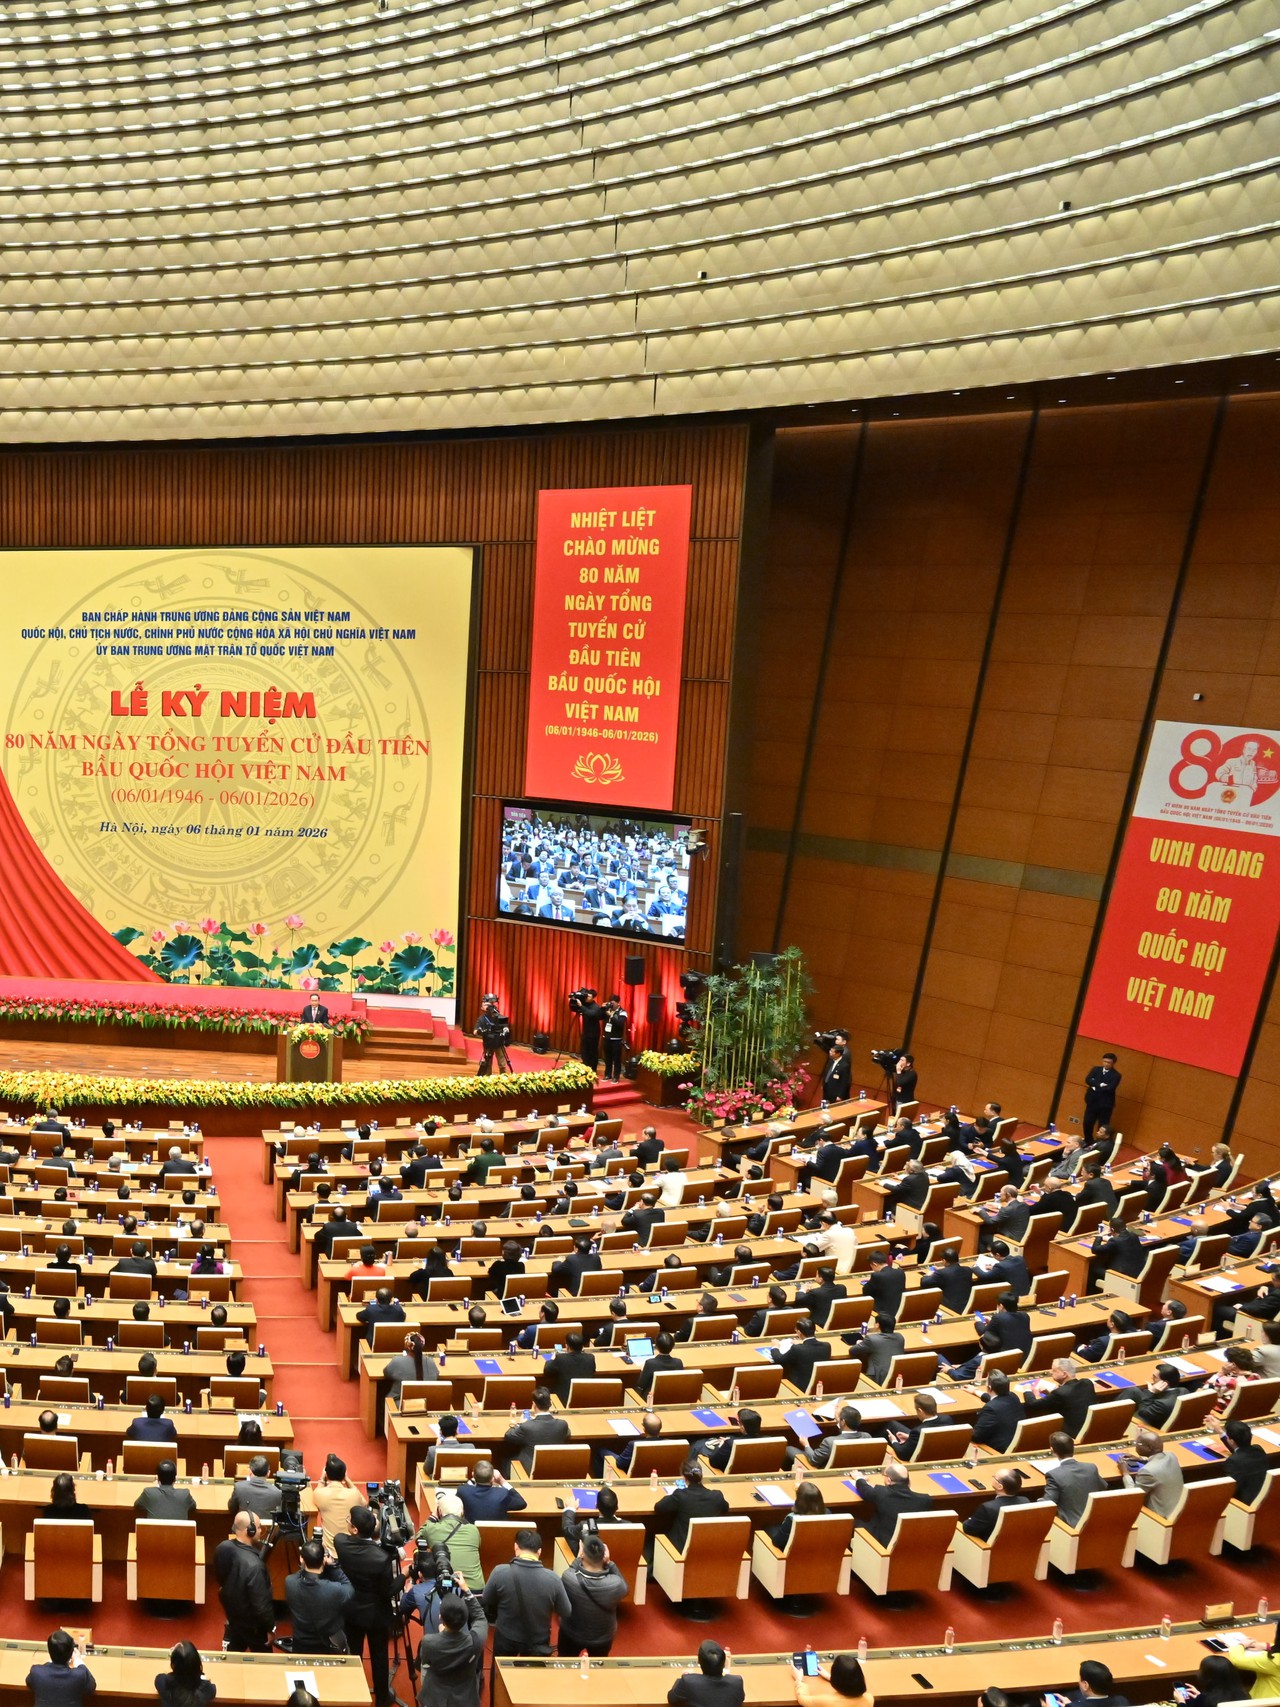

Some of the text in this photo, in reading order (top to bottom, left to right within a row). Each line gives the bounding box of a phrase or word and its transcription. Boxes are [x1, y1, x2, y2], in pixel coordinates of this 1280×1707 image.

[571, 507, 656, 531] NHIỆT LIỆT
[563, 534, 659, 556] CHÀO MỪNG
[579, 564, 639, 583] 80 NĂM
[565, 589, 652, 612] NGÀY TỔNG
[82, 608, 350, 623] BAN CHẤP HÀNH TRUNG ƯƠNG ĐẢNG CỘNG SẢN VIỆT NAM
[21, 625, 45, 639] QUỐC
[48, 627, 67, 641] HỘI,
[69, 625, 87, 639] CHỦ
[90, 628, 110, 641] TỊCH
[113, 626, 142, 640] NƯỚC,
[144, 626, 173, 639] CHÍNH
[176, 625, 195, 639] PHỦ
[198, 626, 224, 639] NƯỚC
[227, 627, 253, 641] CỘNG
[278, 627, 291, 639] XÃ
[294, 627, 310, 641] HỘI
[313, 626, 333, 639] CHỦ
[336, 627, 366, 639] NGHĨA
[368, 627, 389, 641] VIỆT
[392, 629, 416, 639] NAM
[568, 616, 646, 639] TUYỂN CỬ
[96, 641, 334, 658] ỦY BAN TRUNG ƯƠNG MẶT TRẬN TỔ QUỐC VIỆT NAM
[569, 644, 640, 667] ĐẦU TIÊN
[548, 671, 660, 699] BẦU QUỐC HỘI
[111, 681, 316, 724] LỄ KỶ NIỆM
[565, 700, 639, 723] VIỆT NAM
[5, 728, 431, 755] 80 NĂM NGÀY TỔNG TUYỂN CỬ ĐẦU TIÊN
[545, 725, 658, 743] (06/01/1946-06/01/2026)
[82, 754, 346, 784] BẦU QUỐC HỘI VIỆT NAM
[111, 789, 203, 804] (06/01/1946
[220, 791, 315, 808] 06/01/2026)
[100, 822, 328, 838] Hà Nội, ngày 06 tháng 01 năm 2026
[1150, 837, 1265, 879] VINH QUANG
[1156, 887, 1232, 923] 80 NĂM
[1138, 929, 1226, 977] QUỐC HỘI
[1127, 976, 1215, 1020] VIỆT NAM
